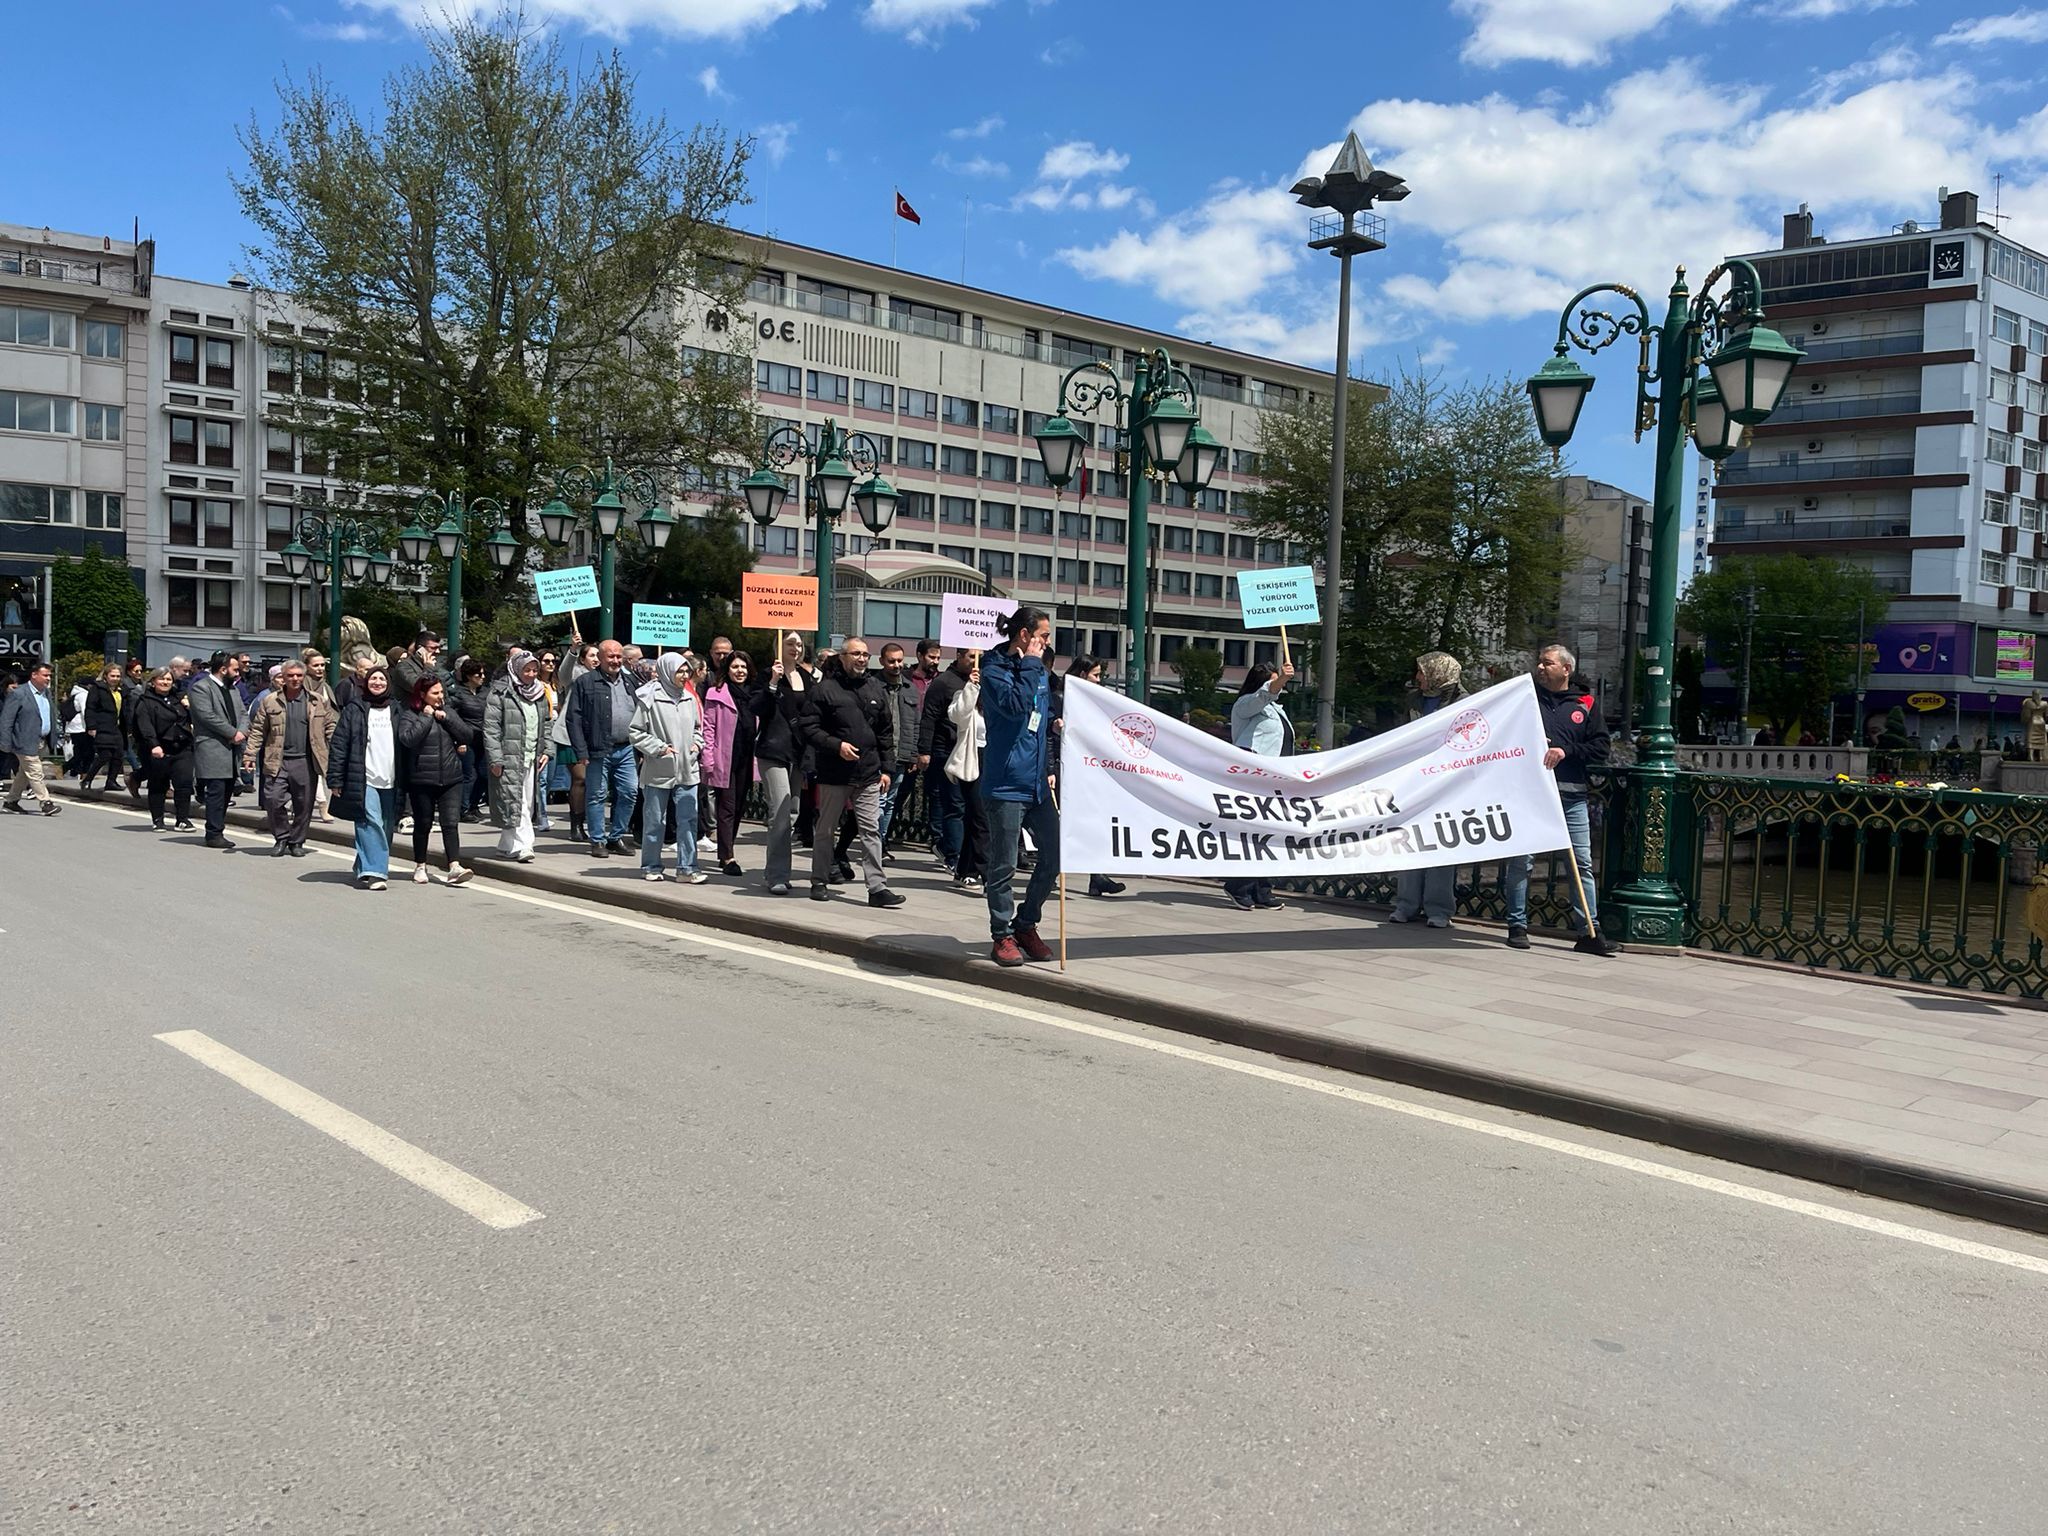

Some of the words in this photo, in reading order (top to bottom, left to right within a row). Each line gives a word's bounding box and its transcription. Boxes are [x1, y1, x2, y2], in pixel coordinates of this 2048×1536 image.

[1697, 478, 1708, 528] OTEL
[1256, 580, 1298, 590] ESKİŞEHİR
[746, 586, 778, 594] DÜZENLİ
[780, 588, 815, 596] EGZERSİZ
[758, 598, 803, 607] SAĞLIĞINIZI
[1260, 593, 1298, 602] YÜRÜYOR
[957, 607, 985, 615] SAĞLIK
[1246, 607, 1277, 615] YÜZLER
[1278, 604, 1315, 612] GÜLÜYOR
[959, 619, 998, 628] HAREKET
[964, 630, 988, 638] GEÇİN
[1911, 696, 1942, 704] gratis
[1420, 766, 1440, 775] T.C.
[1440, 757, 1475, 772] SAĞLIK
[1476, 747, 1525, 765] BAKANLIĞI
[1083, 756, 1099, 767] T.C.
[1101, 759, 1138, 773] SAĞLIK
[1139, 765, 1184, 781] BAKANLIĞI
[1111, 817, 1143, 857] İL
[1151, 822, 1278, 860] SAĞLIK
[1284, 805, 1513, 860] MÜDÜRLÜĞÜ
